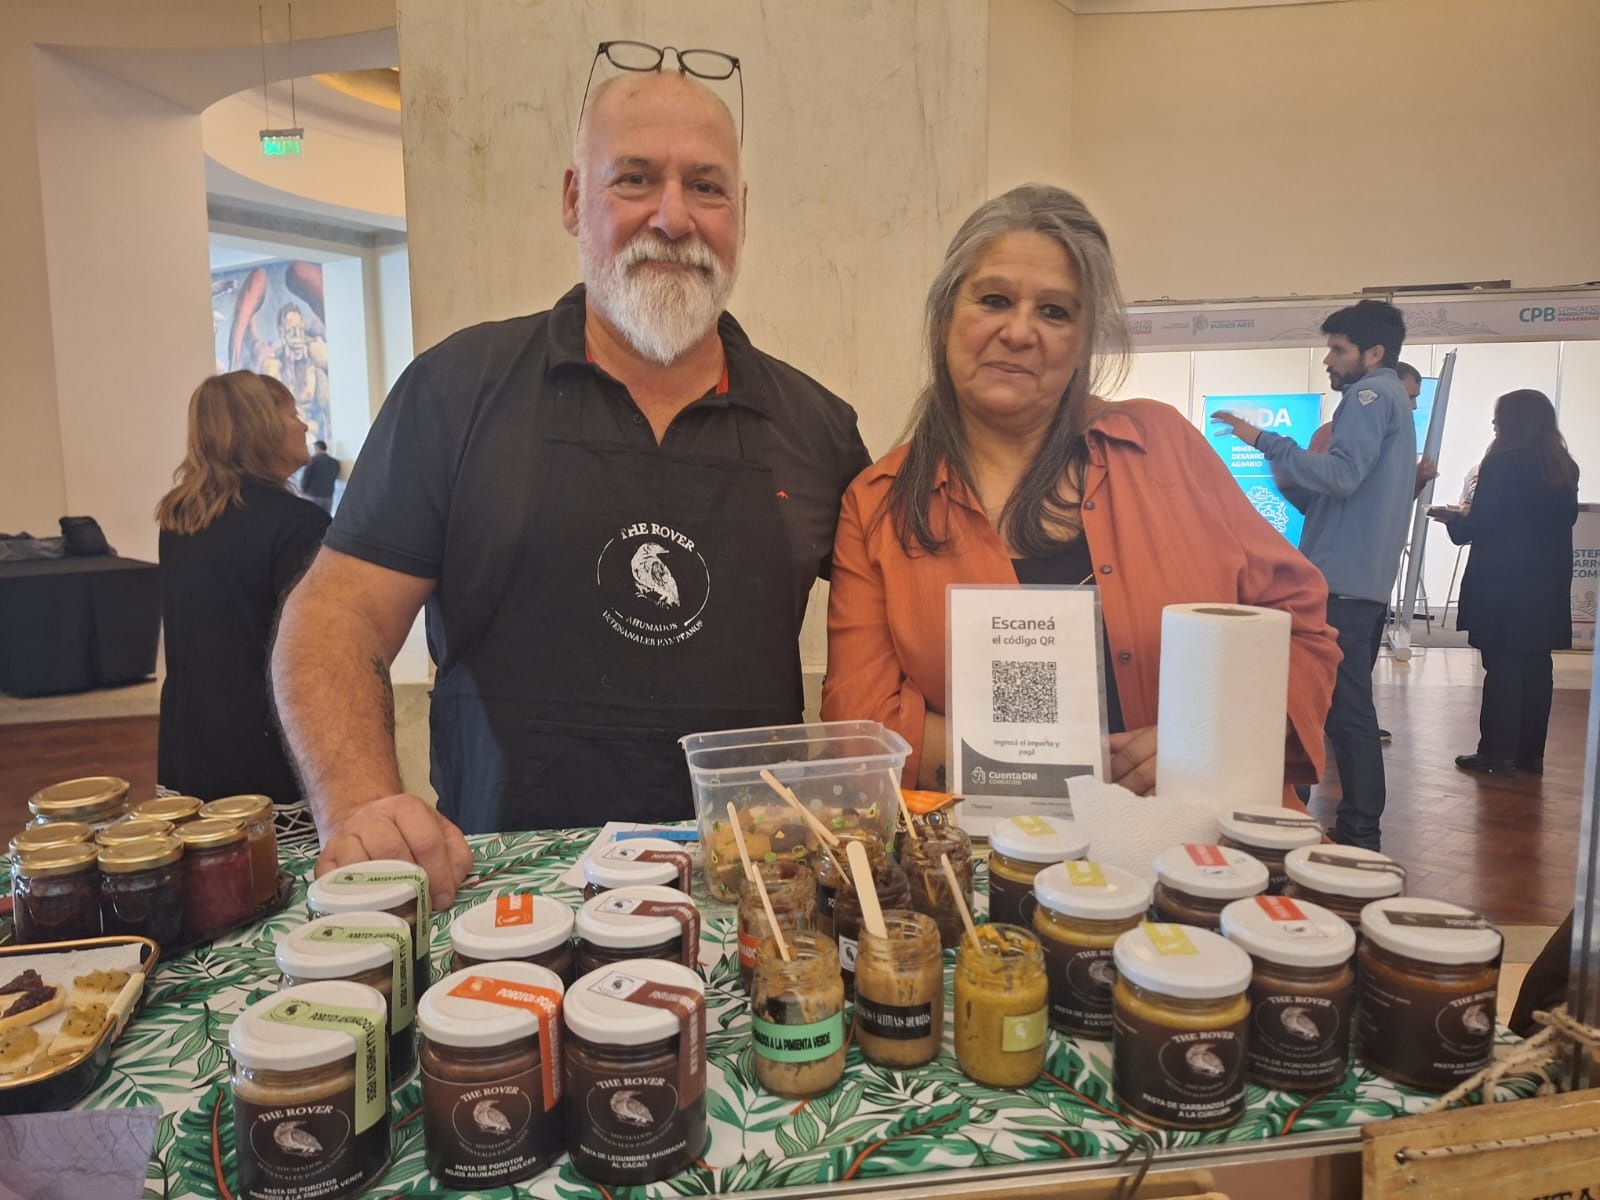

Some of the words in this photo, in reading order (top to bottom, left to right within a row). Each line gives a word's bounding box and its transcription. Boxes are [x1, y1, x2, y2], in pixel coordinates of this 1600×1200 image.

[1519, 307, 1556, 322] CPB
[1231, 460, 1262, 469] AGRARIO
[620, 522, 649, 540] THE
[651, 522, 695, 552] ROVER
[992, 616, 1055, 630] Escaneá
[992, 634, 1001, 645] el
[1003, 634, 1037, 647] código
[1039, 636, 1056, 646] QR
[1267, 996, 1293, 1004] THE
[1295, 996, 1332, 1007] ROVER
[784, 1037, 812, 1051] PIMIENTA
[813, 1032, 831, 1048] VERDE
[1171, 1033, 1198, 1043] THE
[1200, 1031, 1236, 1040] ROVER
[597, 1079, 622, 1089] THE
[623, 1077, 666, 1087] ROVER
[460, 1090, 482, 1103] THE
[484, 1086, 519, 1096] ROVER
[1142, 1092, 1166, 1106] PASTA
[1166, 1100, 1178, 1109] DE
[258, 1110, 284, 1122] THE
[286, 1105, 333, 1117] ROVER
[455, 1163, 476, 1171] PASTA
[489, 1156, 523, 1170] POROTOS
[607, 1153, 651, 1162] LEGUMBRES
[445, 1168, 466, 1177] ROJOS
[467, 1167, 508, 1178] AHUMADOS
[509, 1156, 537, 1172] DULCES
[340, 1170, 363, 1187] VERDE
[264, 1187, 285, 1195] PASTA
[287, 1187, 297, 1195] DE
[299, 1178, 337, 1193] POROTOS
